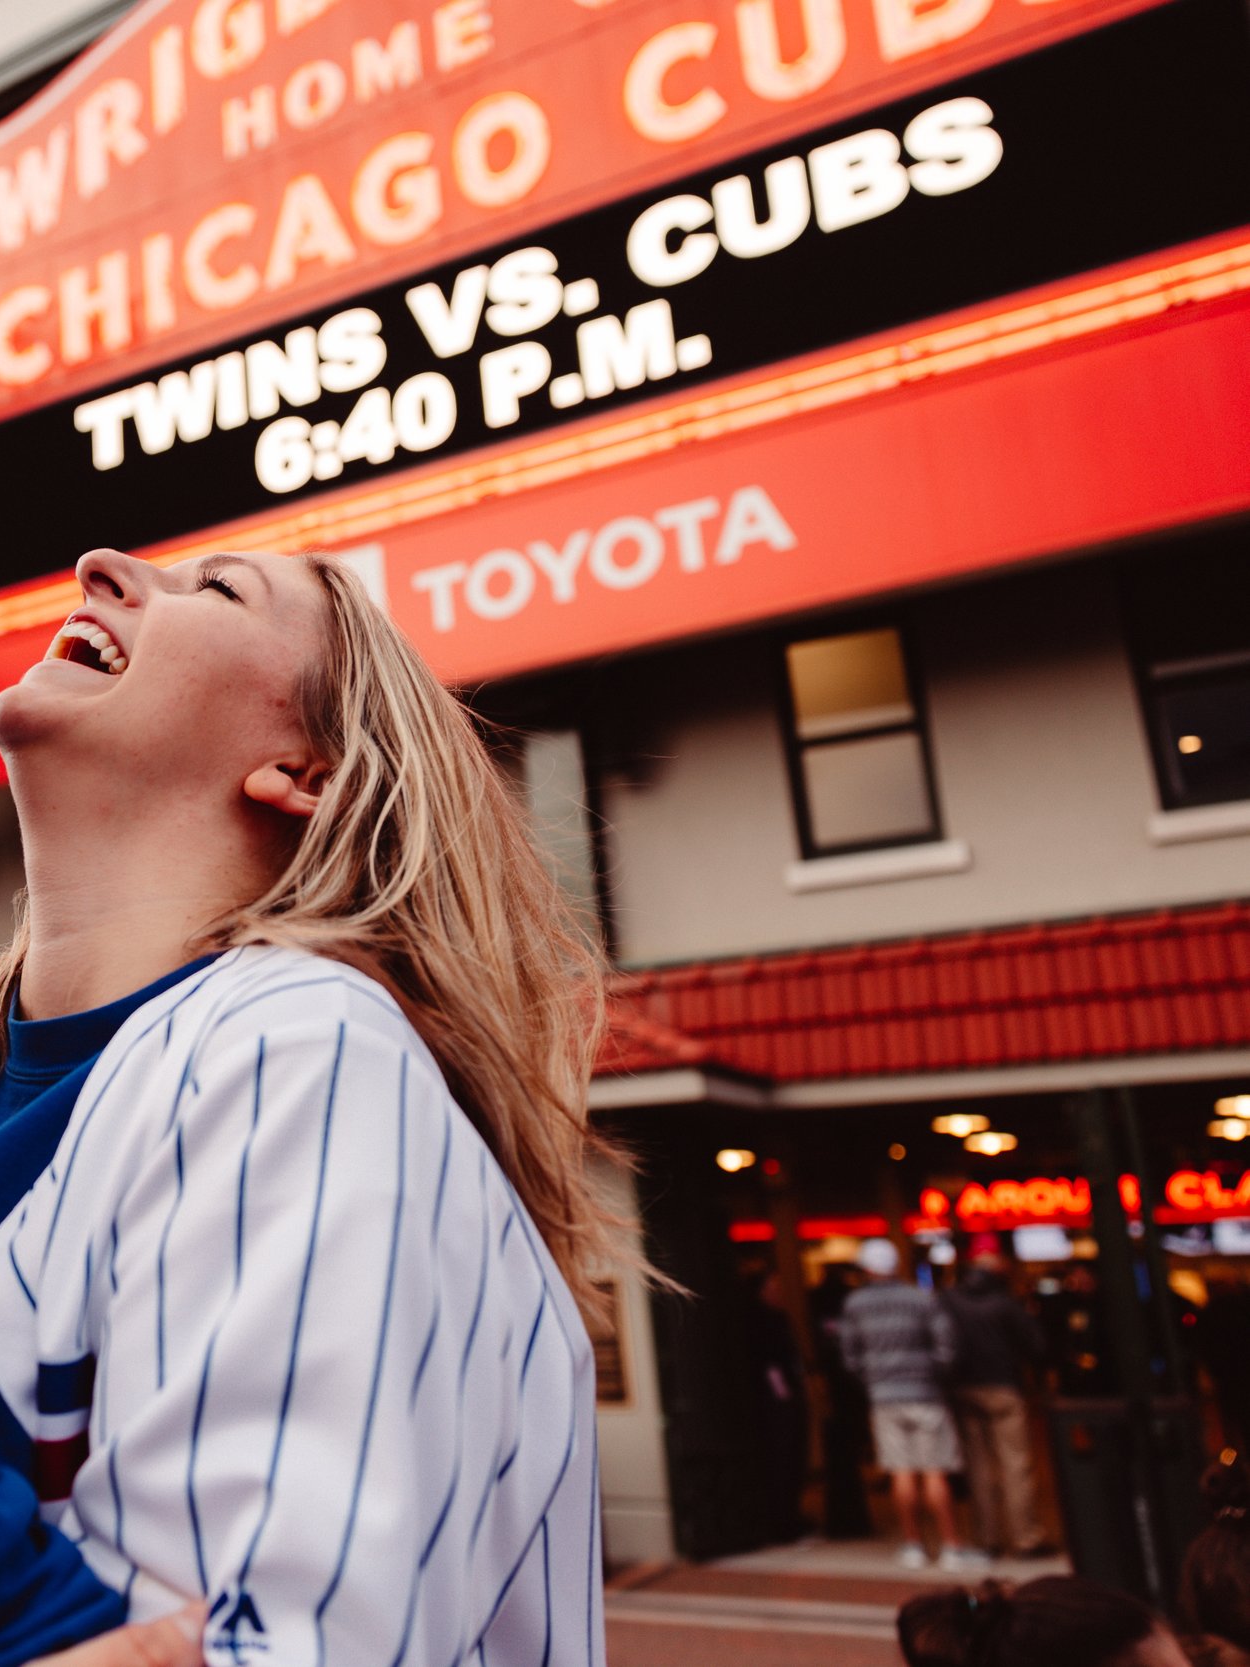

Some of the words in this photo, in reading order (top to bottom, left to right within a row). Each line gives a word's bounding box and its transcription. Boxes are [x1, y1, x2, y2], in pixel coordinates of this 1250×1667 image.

[220, 2, 494, 161] HOME
[623, 0, 1093, 143] CUB
[74, 307, 387, 471] TWINS
[405, 247, 600, 358] VS.
[627, 97, 1003, 288] CUBS
[254, 373, 457, 493] 6:40
[479, 298, 712, 428] P.M.
[411, 484, 798, 633] TOYOTA
